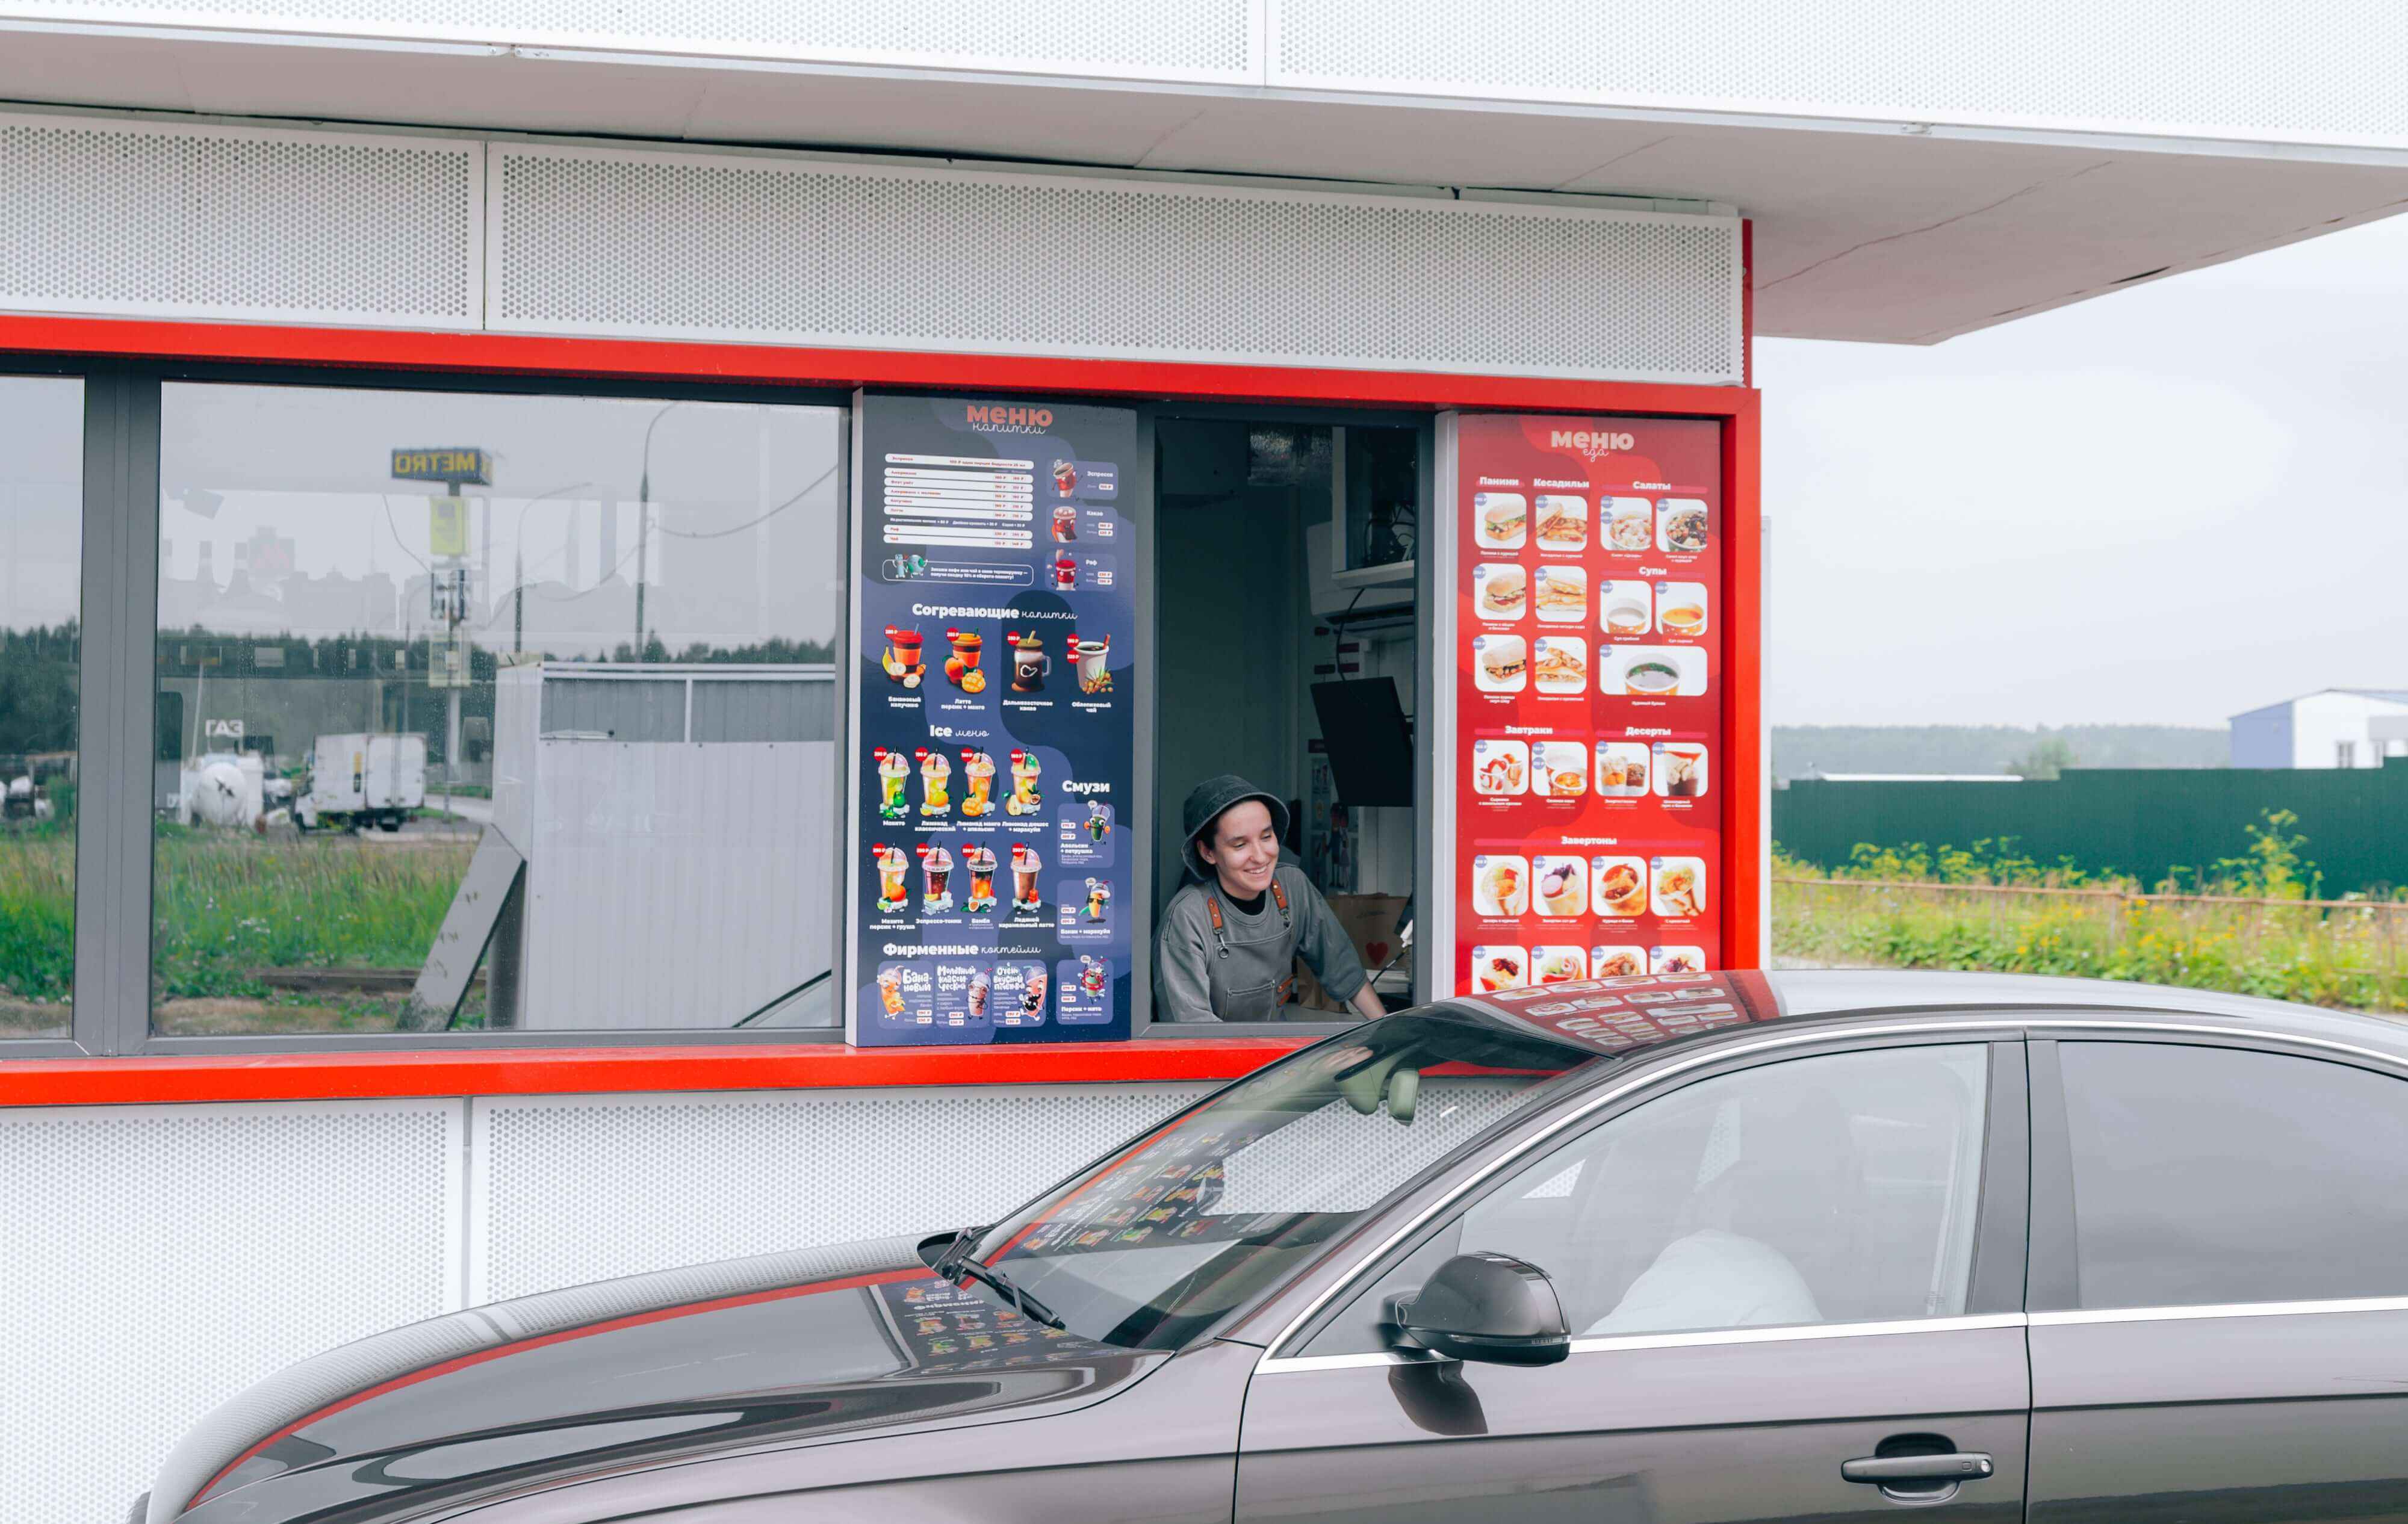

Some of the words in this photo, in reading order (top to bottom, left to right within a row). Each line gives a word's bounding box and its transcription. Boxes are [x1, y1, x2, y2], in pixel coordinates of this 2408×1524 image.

[973, 423, 1046, 434] напитки
[1583, 448, 1609, 462] еда
[1479, 477, 1519, 486] Панини
[1533, 478, 1589, 488] Кесадильи
[1632, 481, 1671, 490] Салаты
[1639, 566, 1667, 576] Супы
[912, 603, 1019, 619] Согревающие
[1022, 610, 1078, 620] напитки
[205, 719, 244, 737] ГАЗ
[929, 725, 952, 737] Ice
[955, 729, 990, 737] меню
[1504, 725, 1553, 736] Завтраки
[1625, 726, 1672, 737] Десерты
[1062, 780, 1110, 795] Смузи
[1561, 835, 1617, 846] Завертоны
[883, 943, 979, 958] Фирменные
[981, 945, 1041, 955] коктейли
